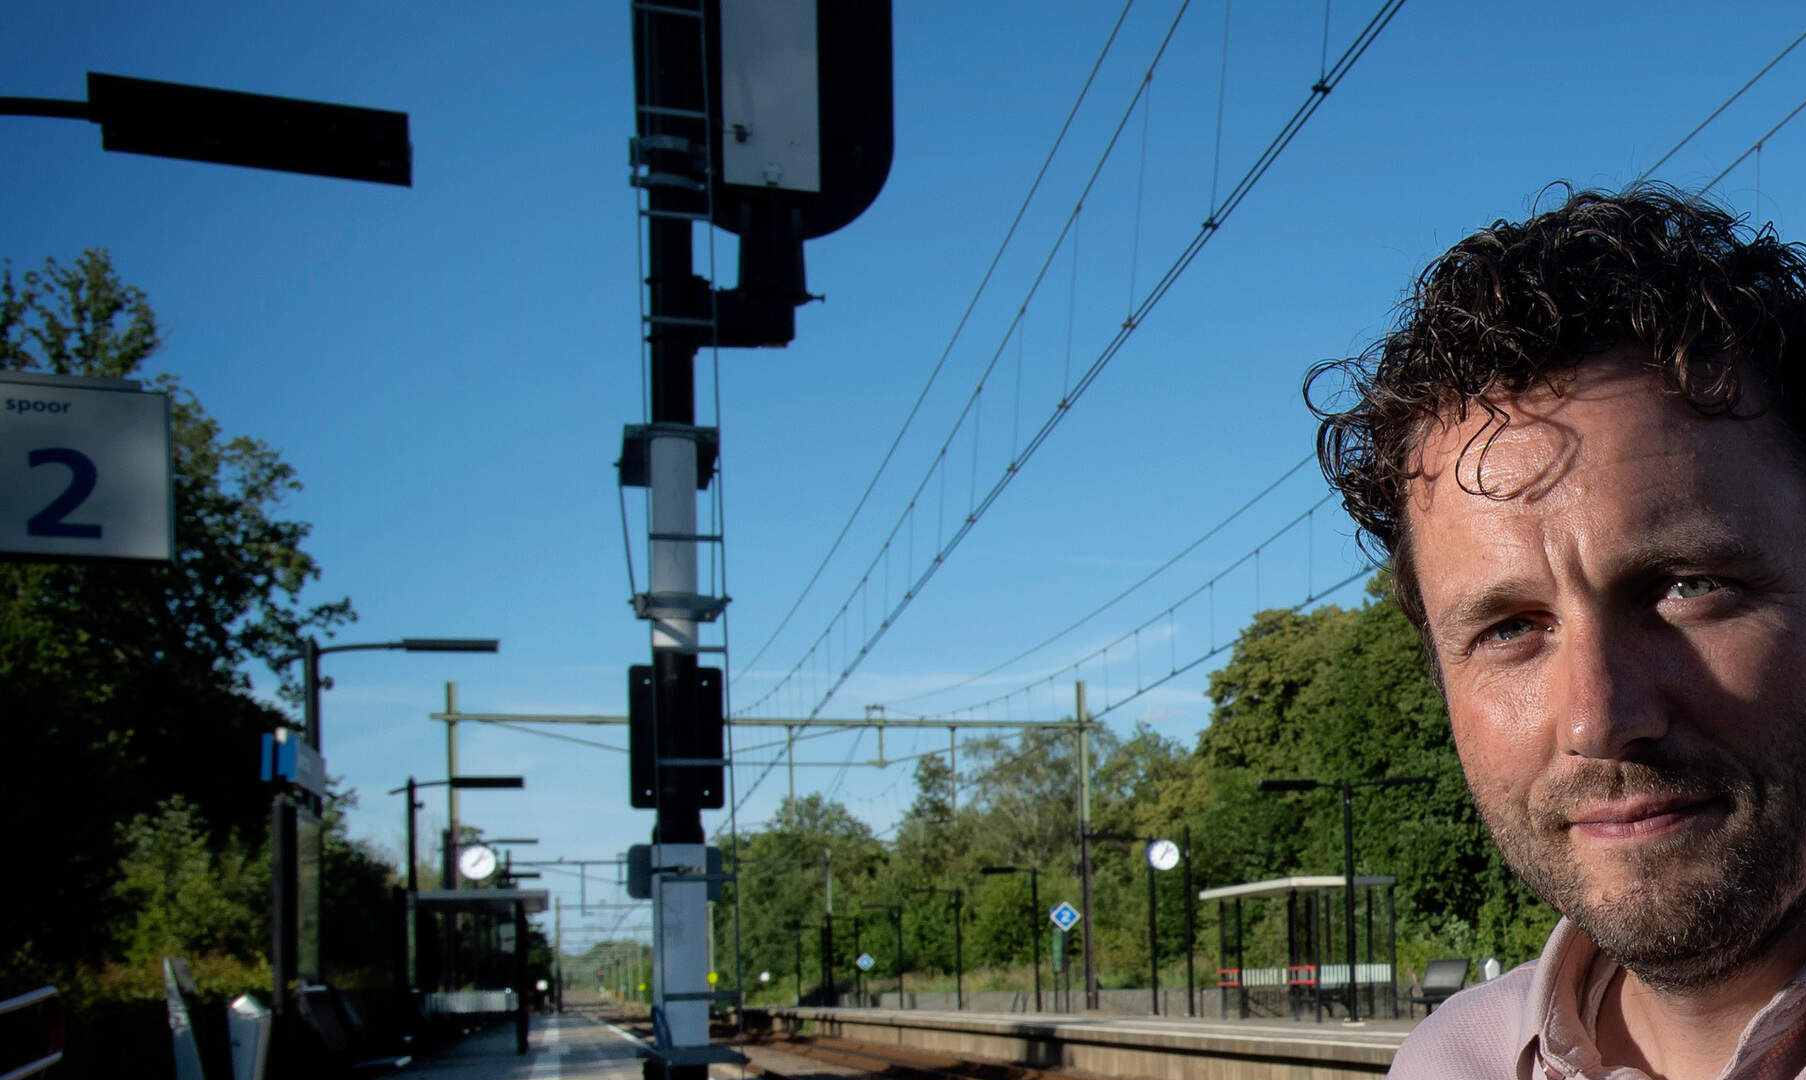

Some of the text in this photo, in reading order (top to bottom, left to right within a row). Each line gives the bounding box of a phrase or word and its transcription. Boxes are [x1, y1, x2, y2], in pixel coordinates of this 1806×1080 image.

[6, 397, 72, 415] spoor
[26, 446, 103, 540] 2
[1060, 910, 1071, 923] 2
